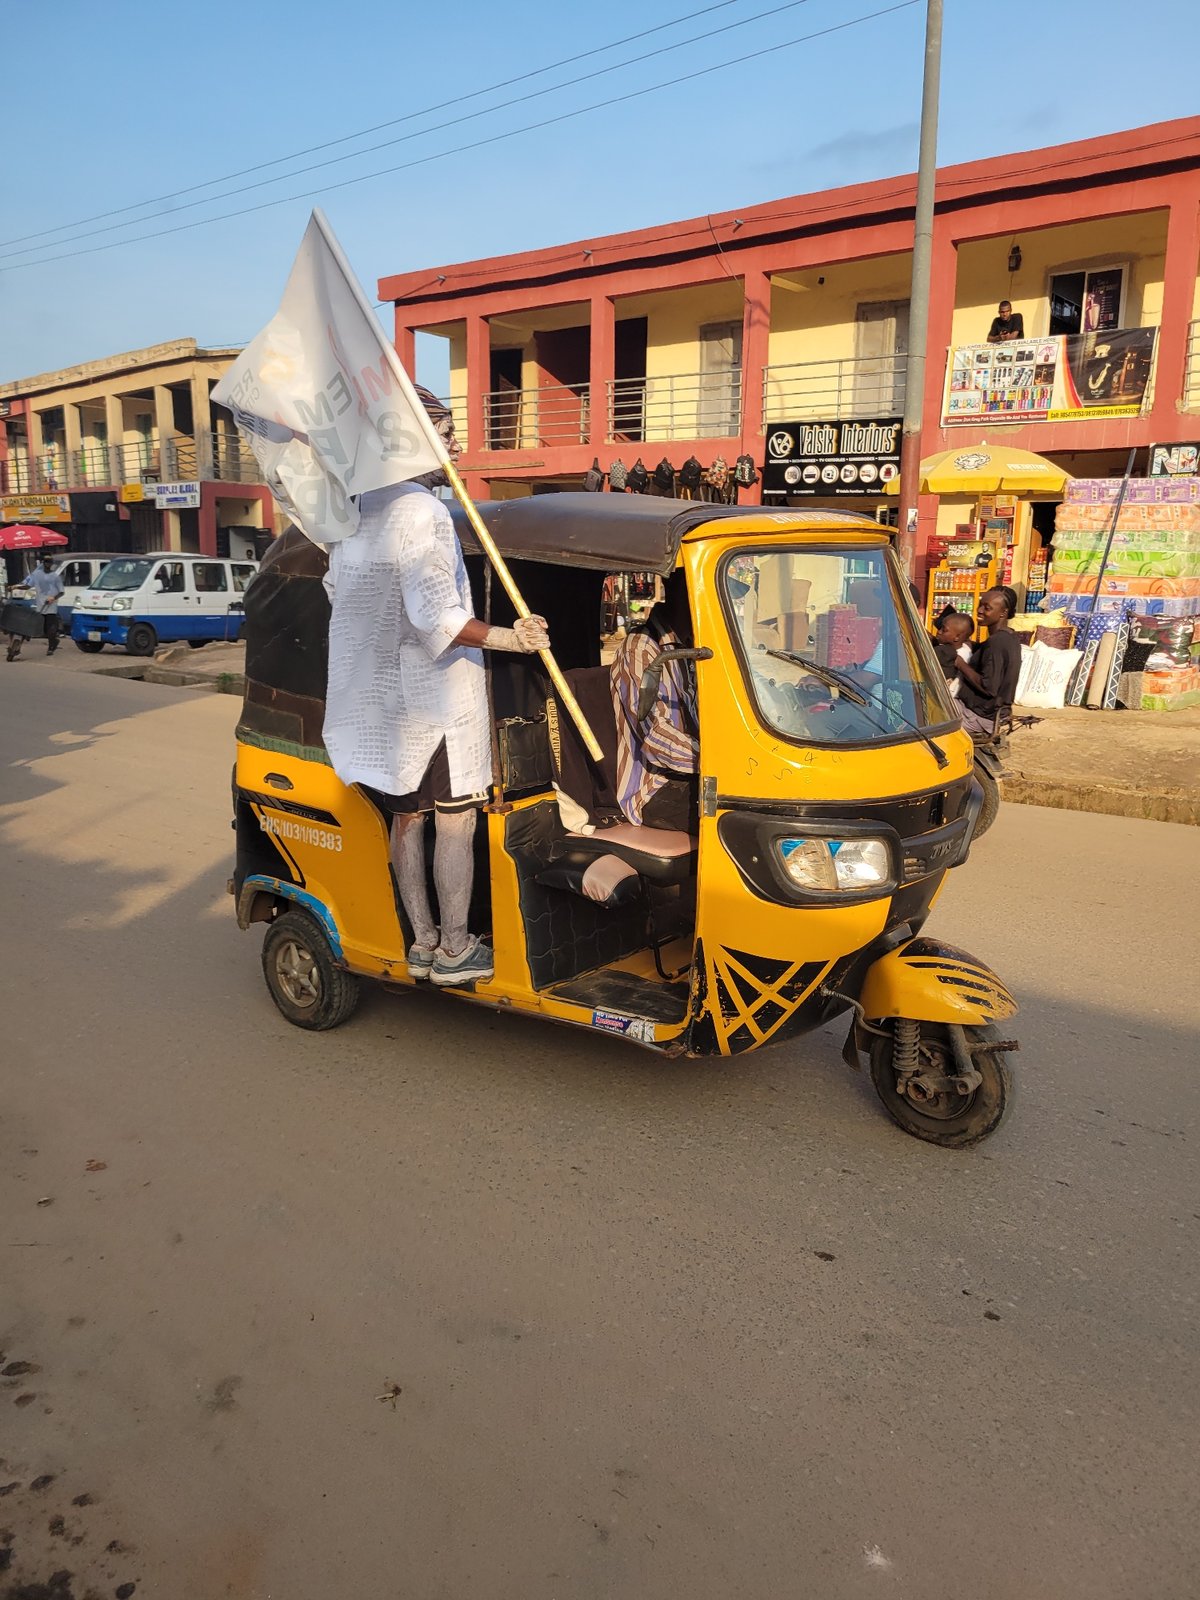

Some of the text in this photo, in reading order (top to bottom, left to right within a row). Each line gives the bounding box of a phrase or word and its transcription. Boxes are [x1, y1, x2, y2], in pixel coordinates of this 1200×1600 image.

[800, 422, 896, 455] Valsix Interiors
[548, 701, 558, 725] LOUIS
